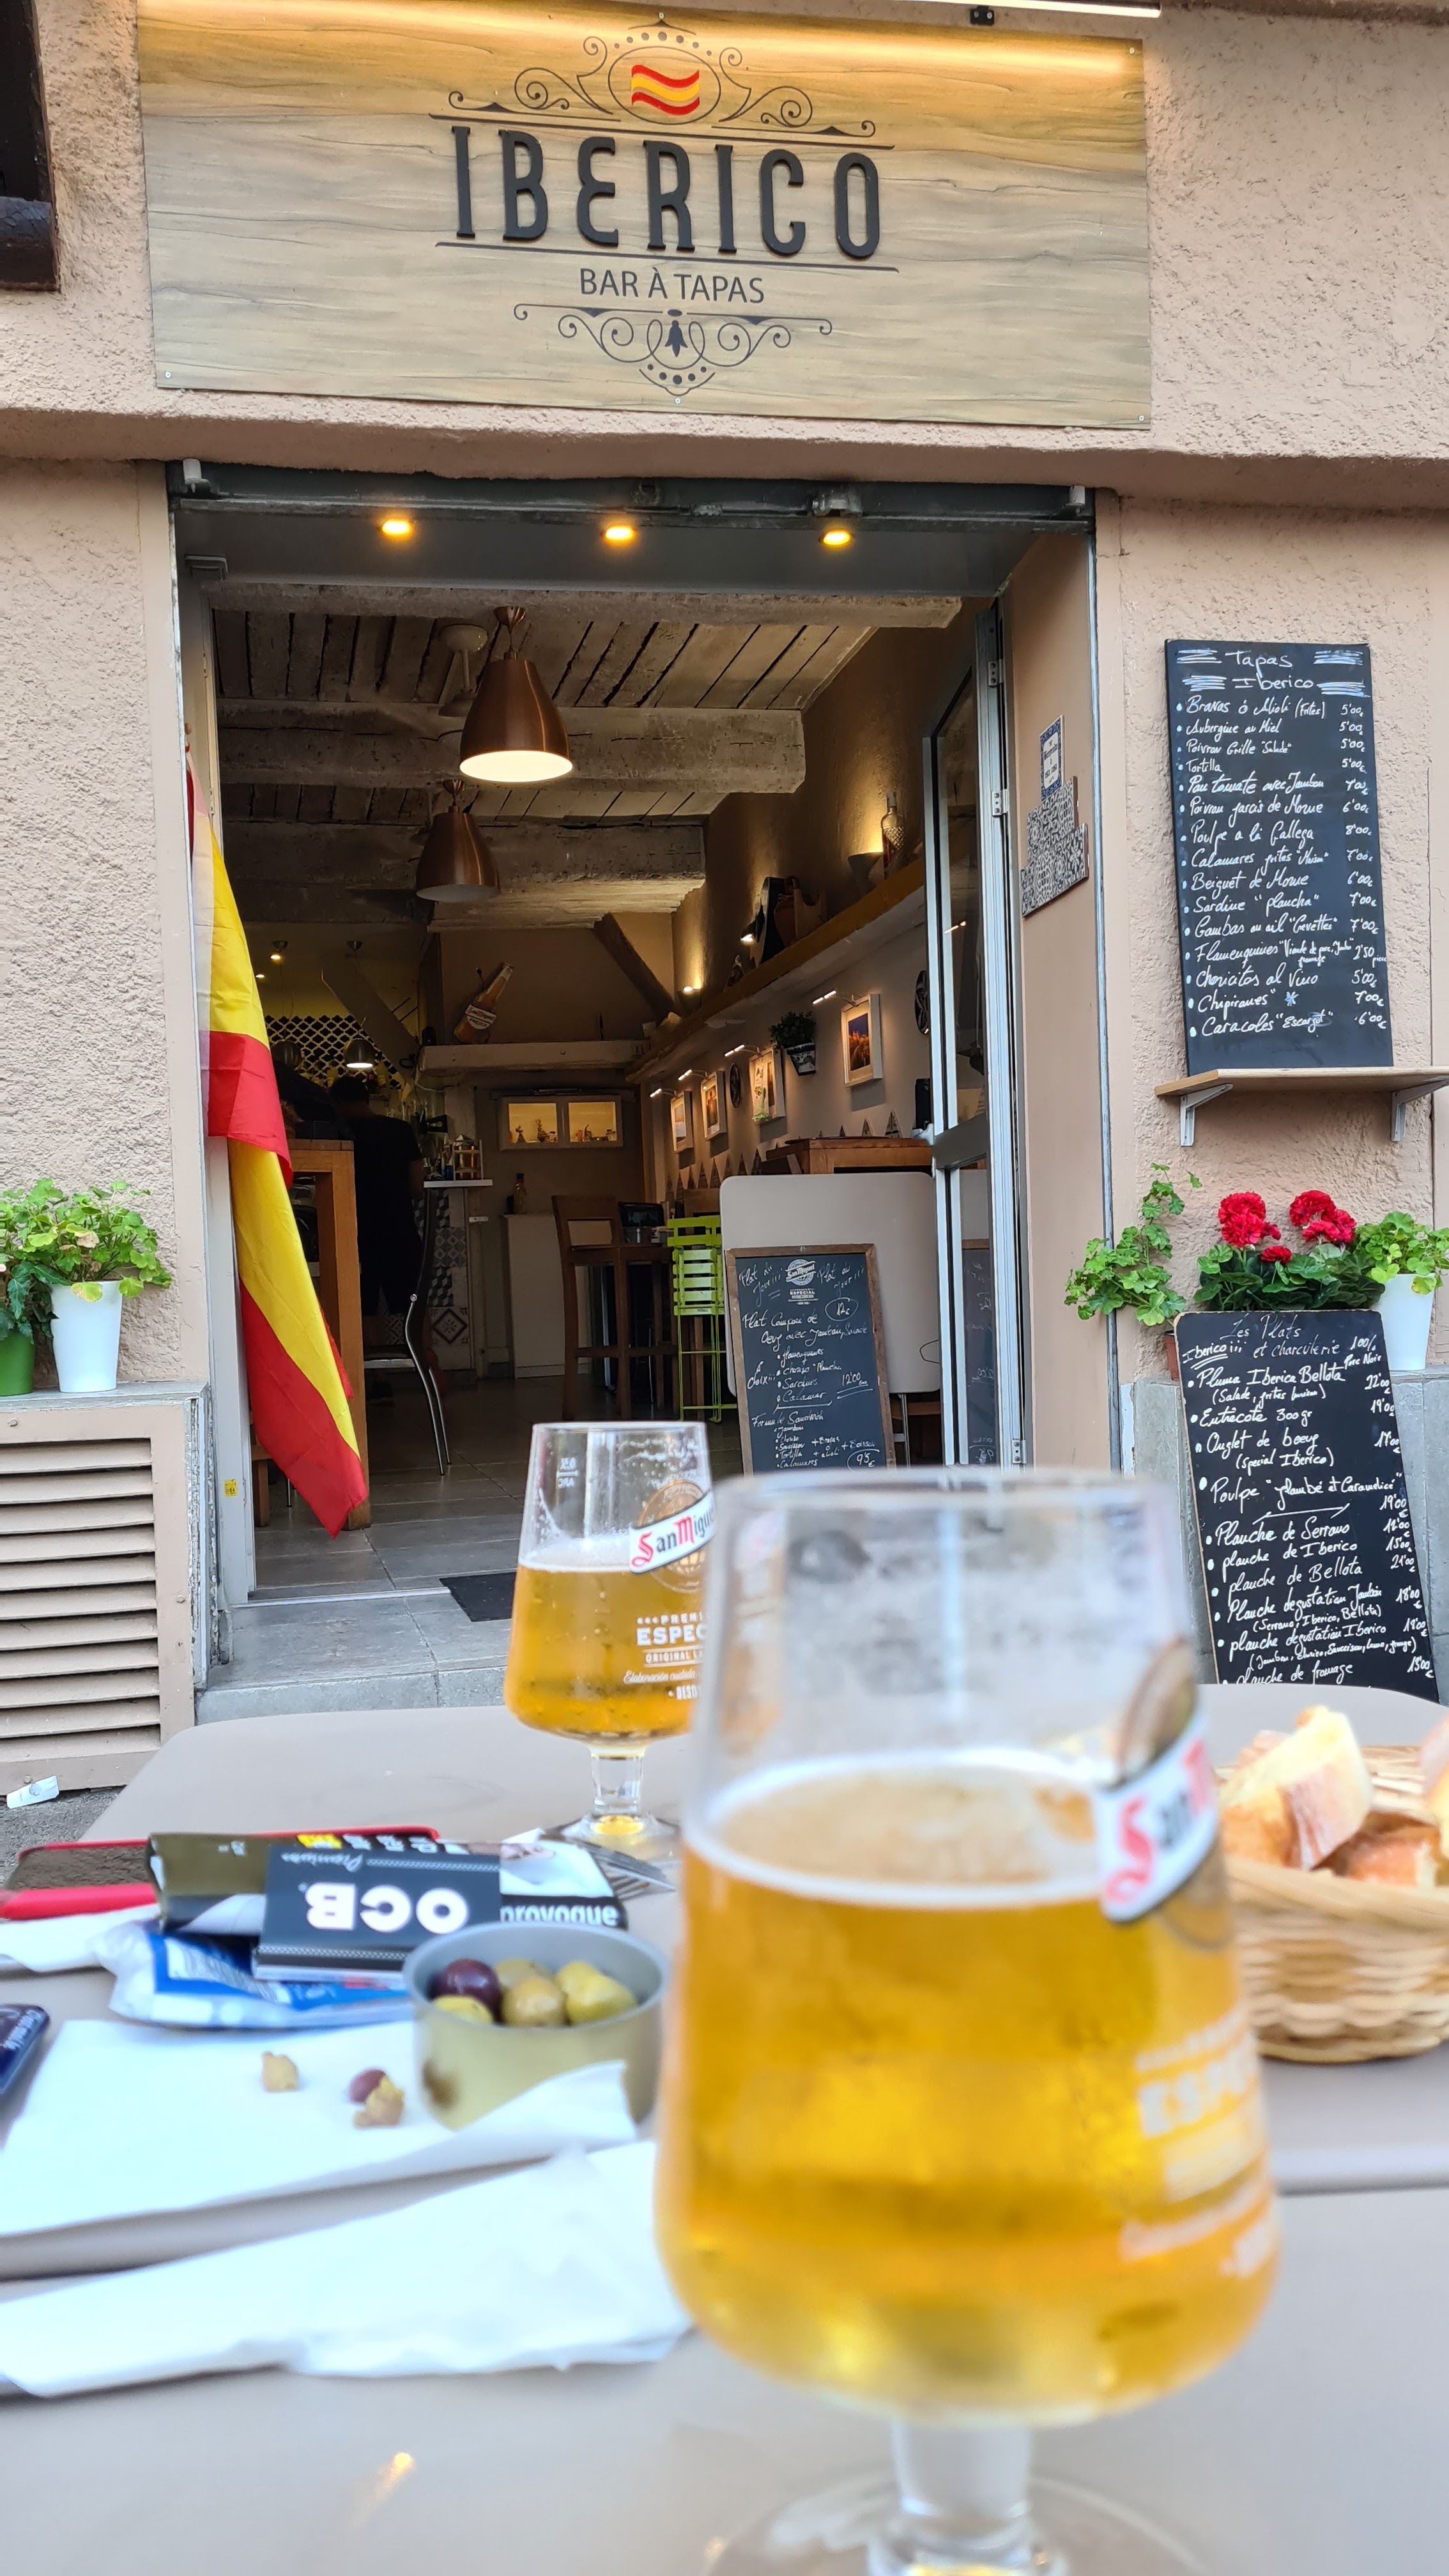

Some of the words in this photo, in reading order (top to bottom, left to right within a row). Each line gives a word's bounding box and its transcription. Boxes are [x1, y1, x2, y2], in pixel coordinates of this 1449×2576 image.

[451, 126, 880, 258] IBERICO
[580, 268, 638, 298] BAR
[648, 266, 668, 299] À
[673, 273, 765, 304] TAPAS
[1225, 650, 1292, 673] Tapas
[1232, 673, 1314, 690] Iberico
[1259, 718, 1282, 733] Miel
[1186, 758, 1222, 772] Tortilla
[1268, 794, 1281, 813] de
[1192, 848, 1255, 868] Calamares
[1249, 868, 1262, 889] de
[1193, 894, 1245, 913] Sardine
[1195, 914, 1245, 938] Gambas
[1266, 962, 1286, 985] al
[1289, 969, 1318, 987] Vino
[1202, 1013, 1274, 1036] Caracoles
[1182, 1342, 1227, 1363] Iberico
[1254, 1341, 1268, 1358] et
[1363, 1353, 1382, 1365] Noir
[1246, 1367, 1297, 1386] Iberica
[1298, 1362, 1346, 1383] Bellota
[1257, 1430, 1270, 1447] de
[1282, 1521, 1296, 1540] de
[630, 1531, 677, 1568] San
[1283, 1542, 1298, 1560] de
[1300, 1540, 1358, 1558] Iberico
[1287, 1568, 1302, 1586] de
[1308, 1556, 1363, 1583] Bellota
[636, 1623, 707, 1646] ESPEC
[1342, 1620, 1386, 1637] Iberico
[1291, 1664, 1304, 1681] de
[305, 1882, 468, 1935] OCB
